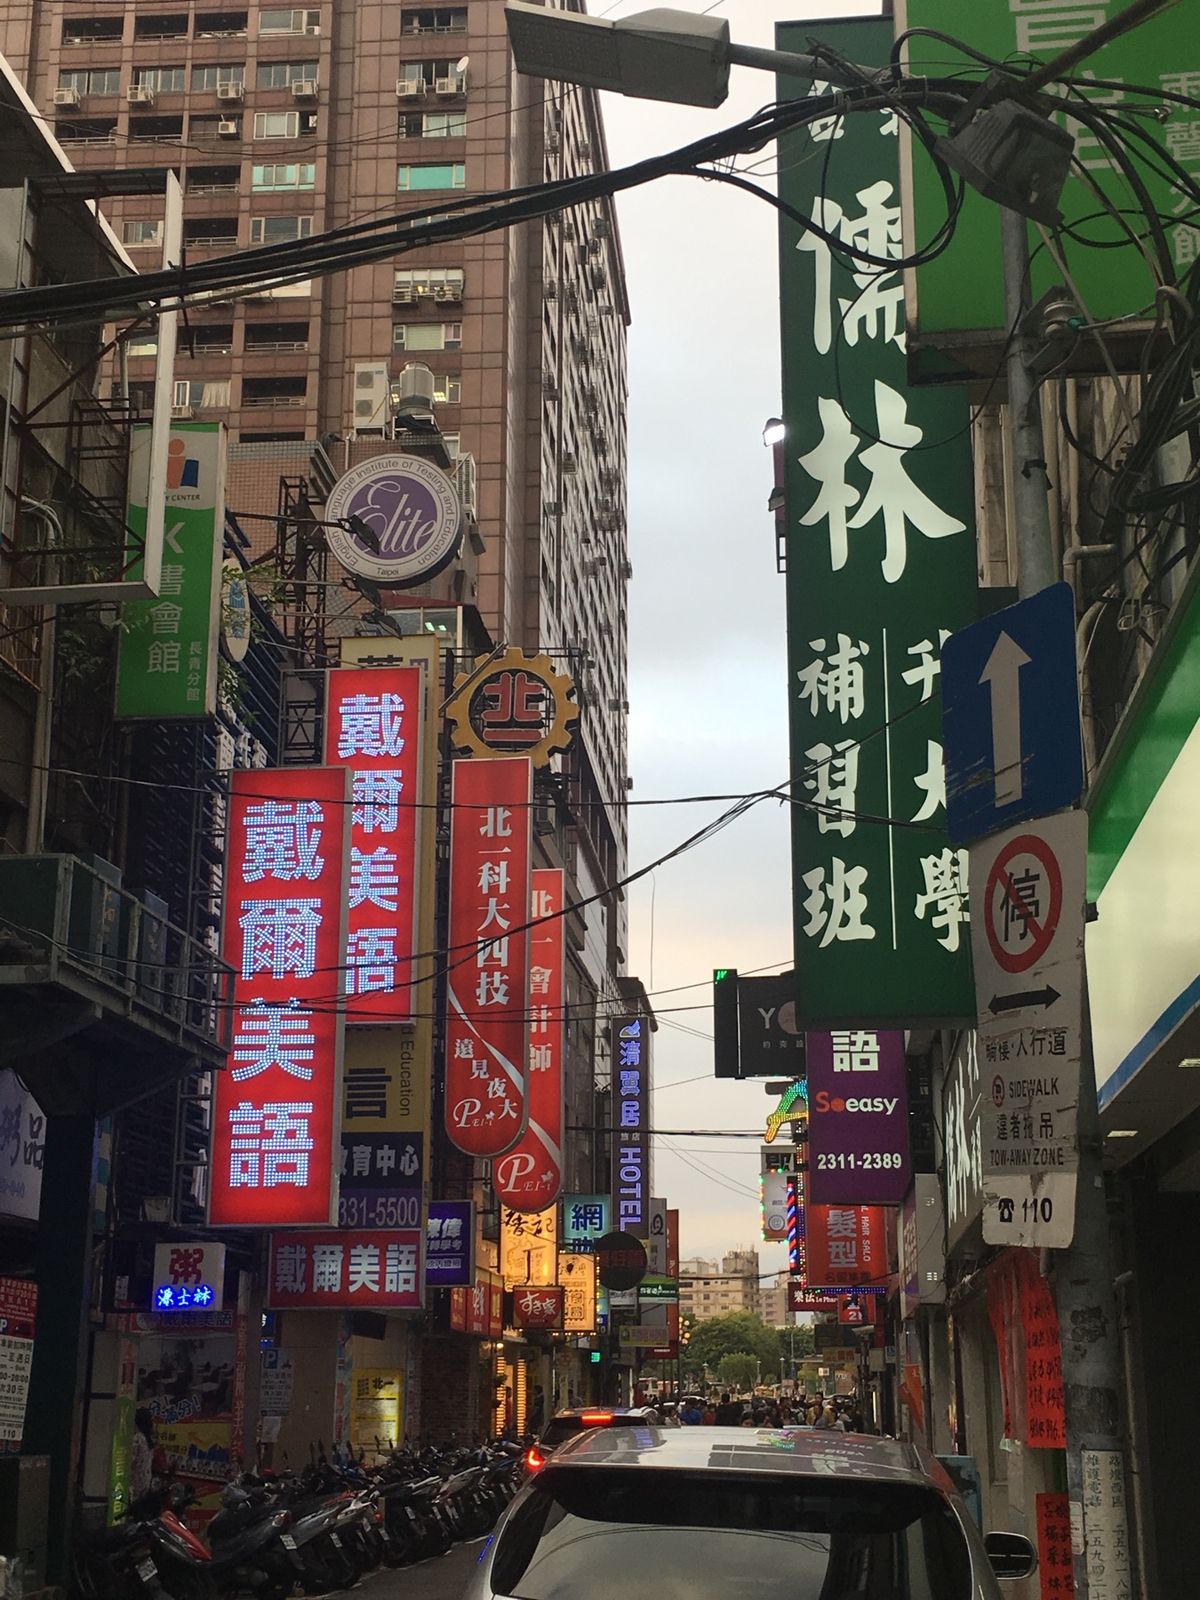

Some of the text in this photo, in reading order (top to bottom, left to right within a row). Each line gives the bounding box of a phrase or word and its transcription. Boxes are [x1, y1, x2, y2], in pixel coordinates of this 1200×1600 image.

[356, 459, 400, 479] Institute
[402, 461, 414, 470] of
[415, 463, 447, 495] Testing
[351, 480, 437, 553] Elite
[417, 518, 456, 566] Education
[376, 567, 400, 577] Taipei
[797, 632, 877, 949] 補習班
[475, 806, 513, 1007] 北一科大四技
[1000, 868, 1041, 943] 停
[228, 799, 325, 1189] 戴爾美語
[830, 1030, 881, 1072] 語
[399, 1040, 415, 1117] Education
[1008, 1076, 1060, 1099] SIDEWALK
[816, 1152, 902, 1170] 2311-2389
[619, 1147, 642, 1232] HOTEL
[1021, 1196, 1054, 1225] 110
[276, 1243, 418, 1295] 戴爾美語
